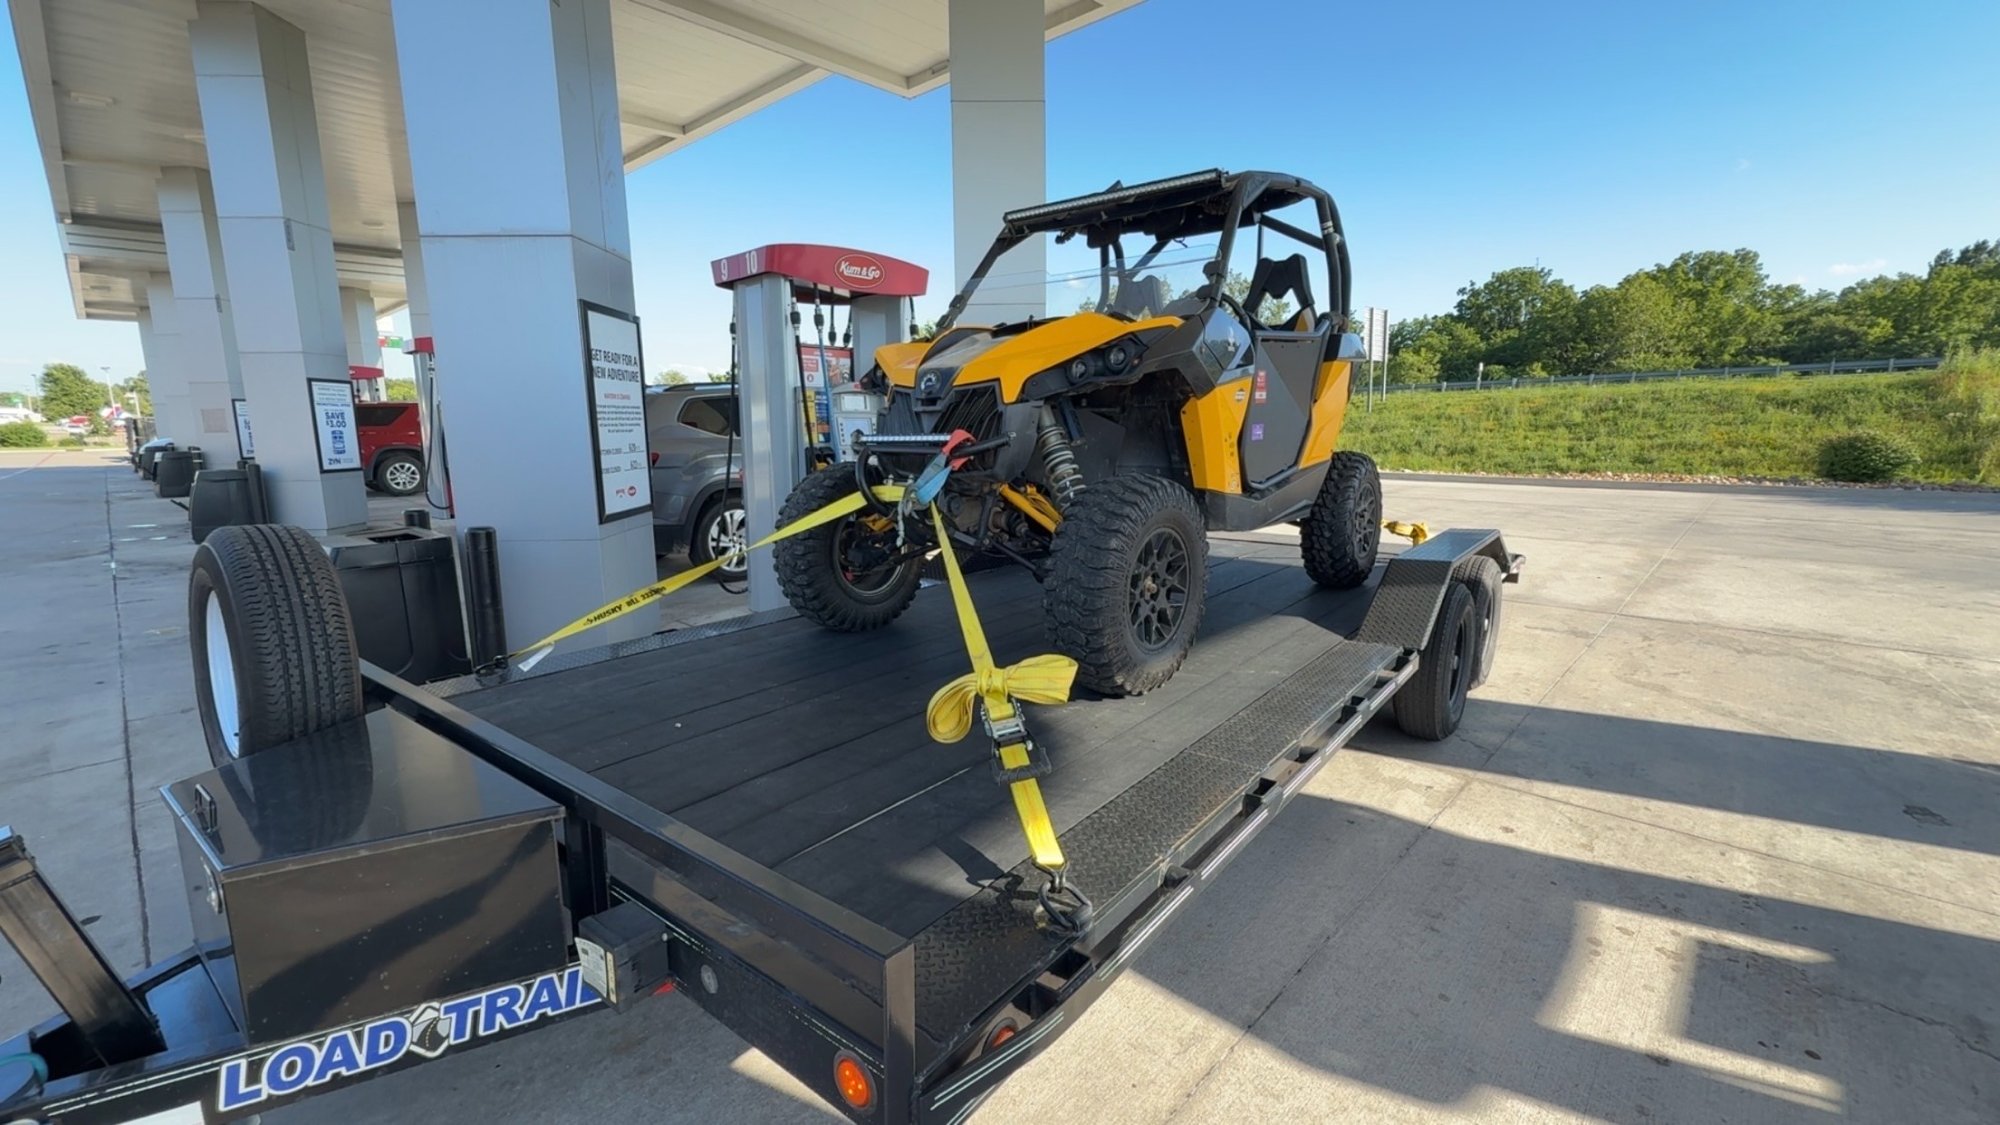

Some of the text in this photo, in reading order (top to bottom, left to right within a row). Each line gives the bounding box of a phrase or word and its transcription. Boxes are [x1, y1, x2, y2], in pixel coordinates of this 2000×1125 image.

[720, 250, 758, 281] 9 10
[591, 348, 639, 367] GET READY FOR A
[592, 366, 640, 383] NEW ADVENTURE
[325, 411, 345, 421] SAVE
[328, 458, 341, 466] ZYN
[594, 604, 622, 621] HUSKY
[218, 1017, 412, 1112] LOAD
